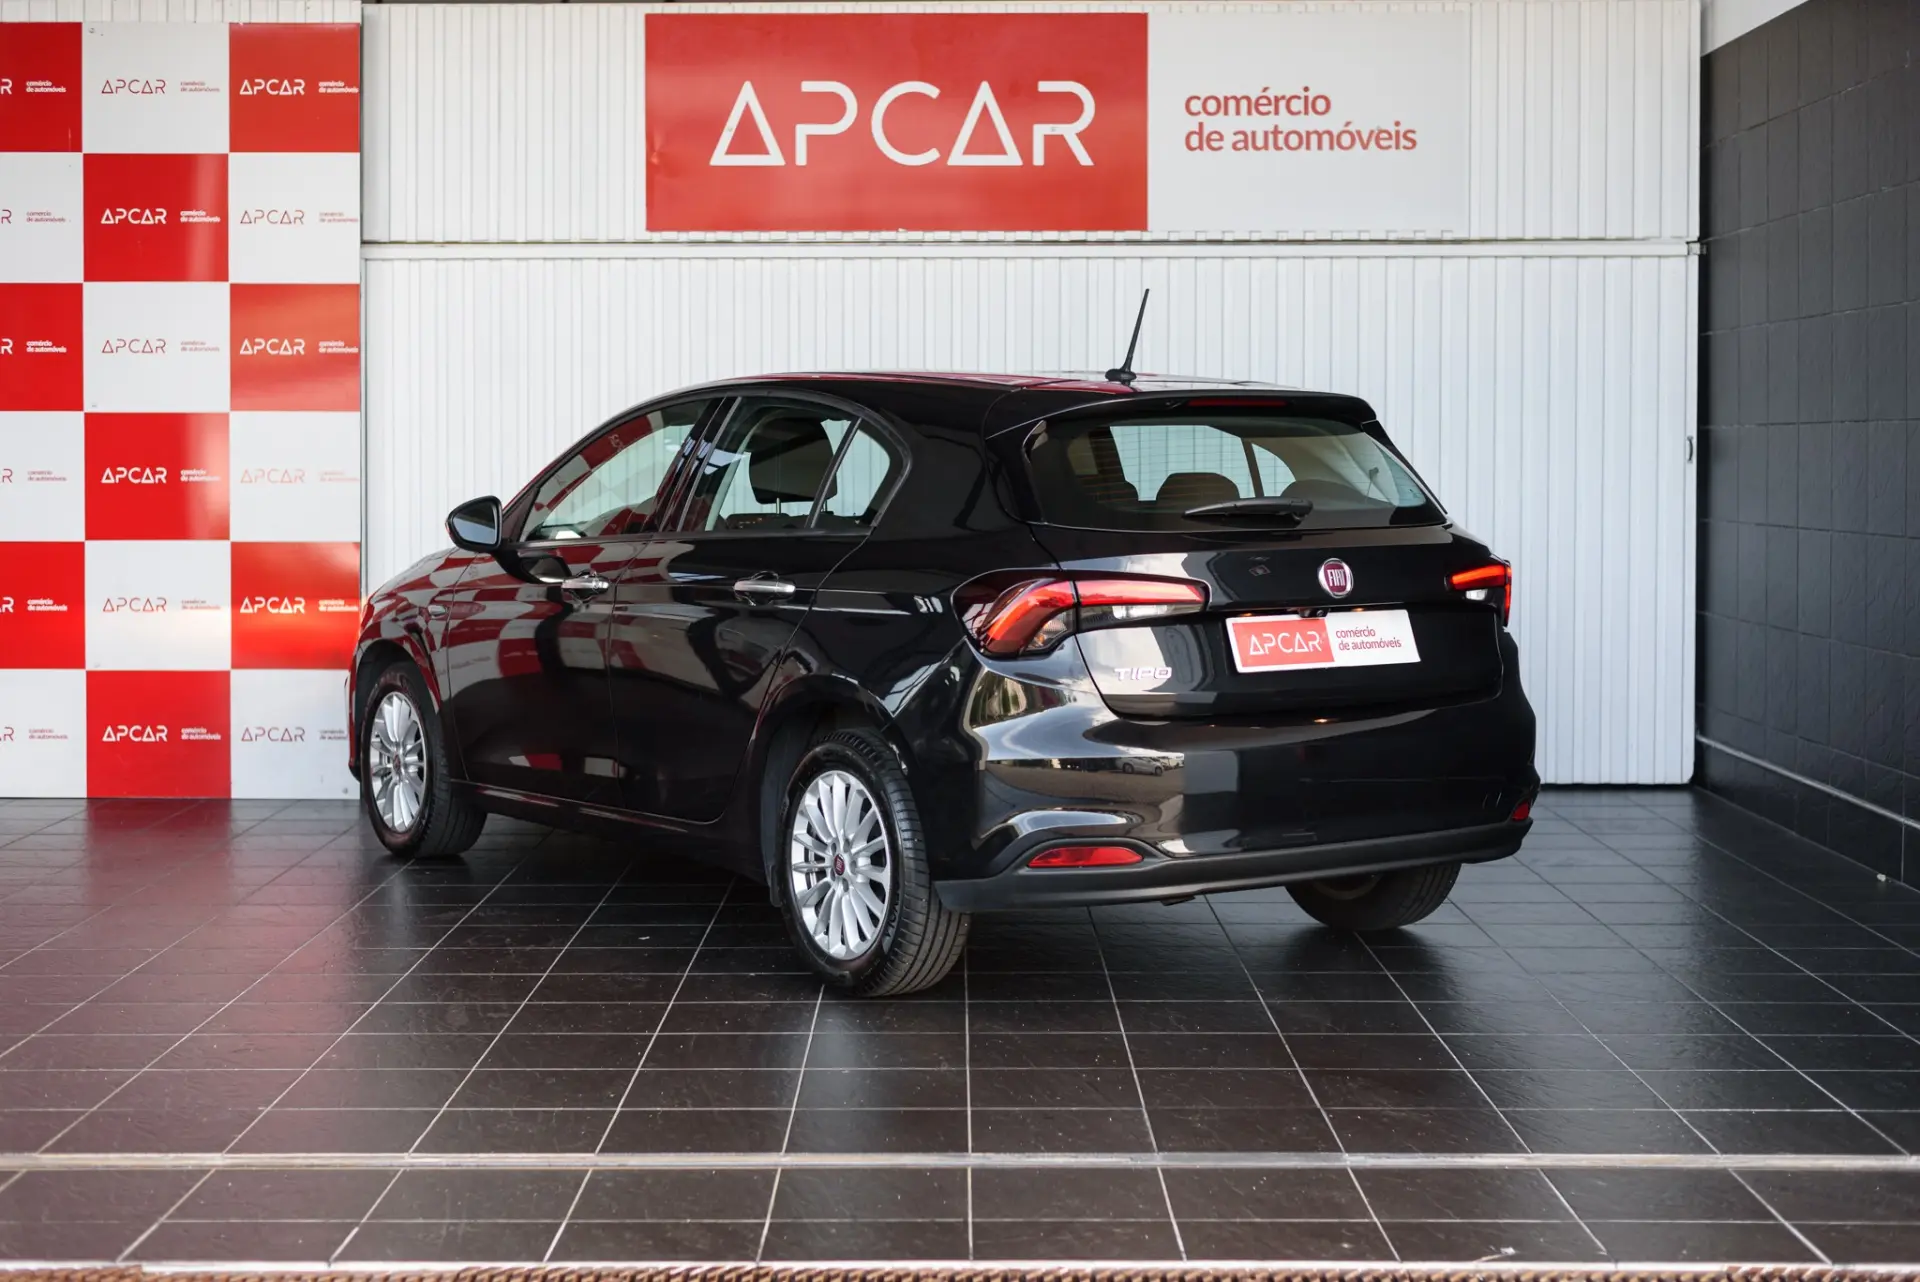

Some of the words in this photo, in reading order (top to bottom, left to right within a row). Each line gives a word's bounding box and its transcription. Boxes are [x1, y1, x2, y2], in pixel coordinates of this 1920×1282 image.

[101, 79, 166, 94] APCAR
[239, 79, 305, 95] APCAR
[1184, 86, 1331, 116] comércio
[709, 80, 1095, 166] APCAR
[1184, 121, 1224, 151] de
[1231, 120, 1418, 151] automóveis
[100, 208, 167, 224] APCAR
[240, 209, 305, 224] APCAR
[101, 338, 166, 353] APCAR
[239, 338, 305, 355] APCAR
[101, 467, 167, 484] APCAR
[240, 468, 306, 484] APCAR
[1327, 569, 1346, 587] FIAT
[102, 597, 167, 612] APCAR
[239, 597, 305, 613] APCAR
[1335, 626, 1376, 638] comércio
[1249, 630, 1322, 656] APCAR
[1338, 639, 1350, 651] de
[1351, 637, 1402, 650] automóveis
[1113, 666, 1173, 681] TIPO
[102, 725, 168, 742] APCAR
[241, 726, 305, 742] APCAR
